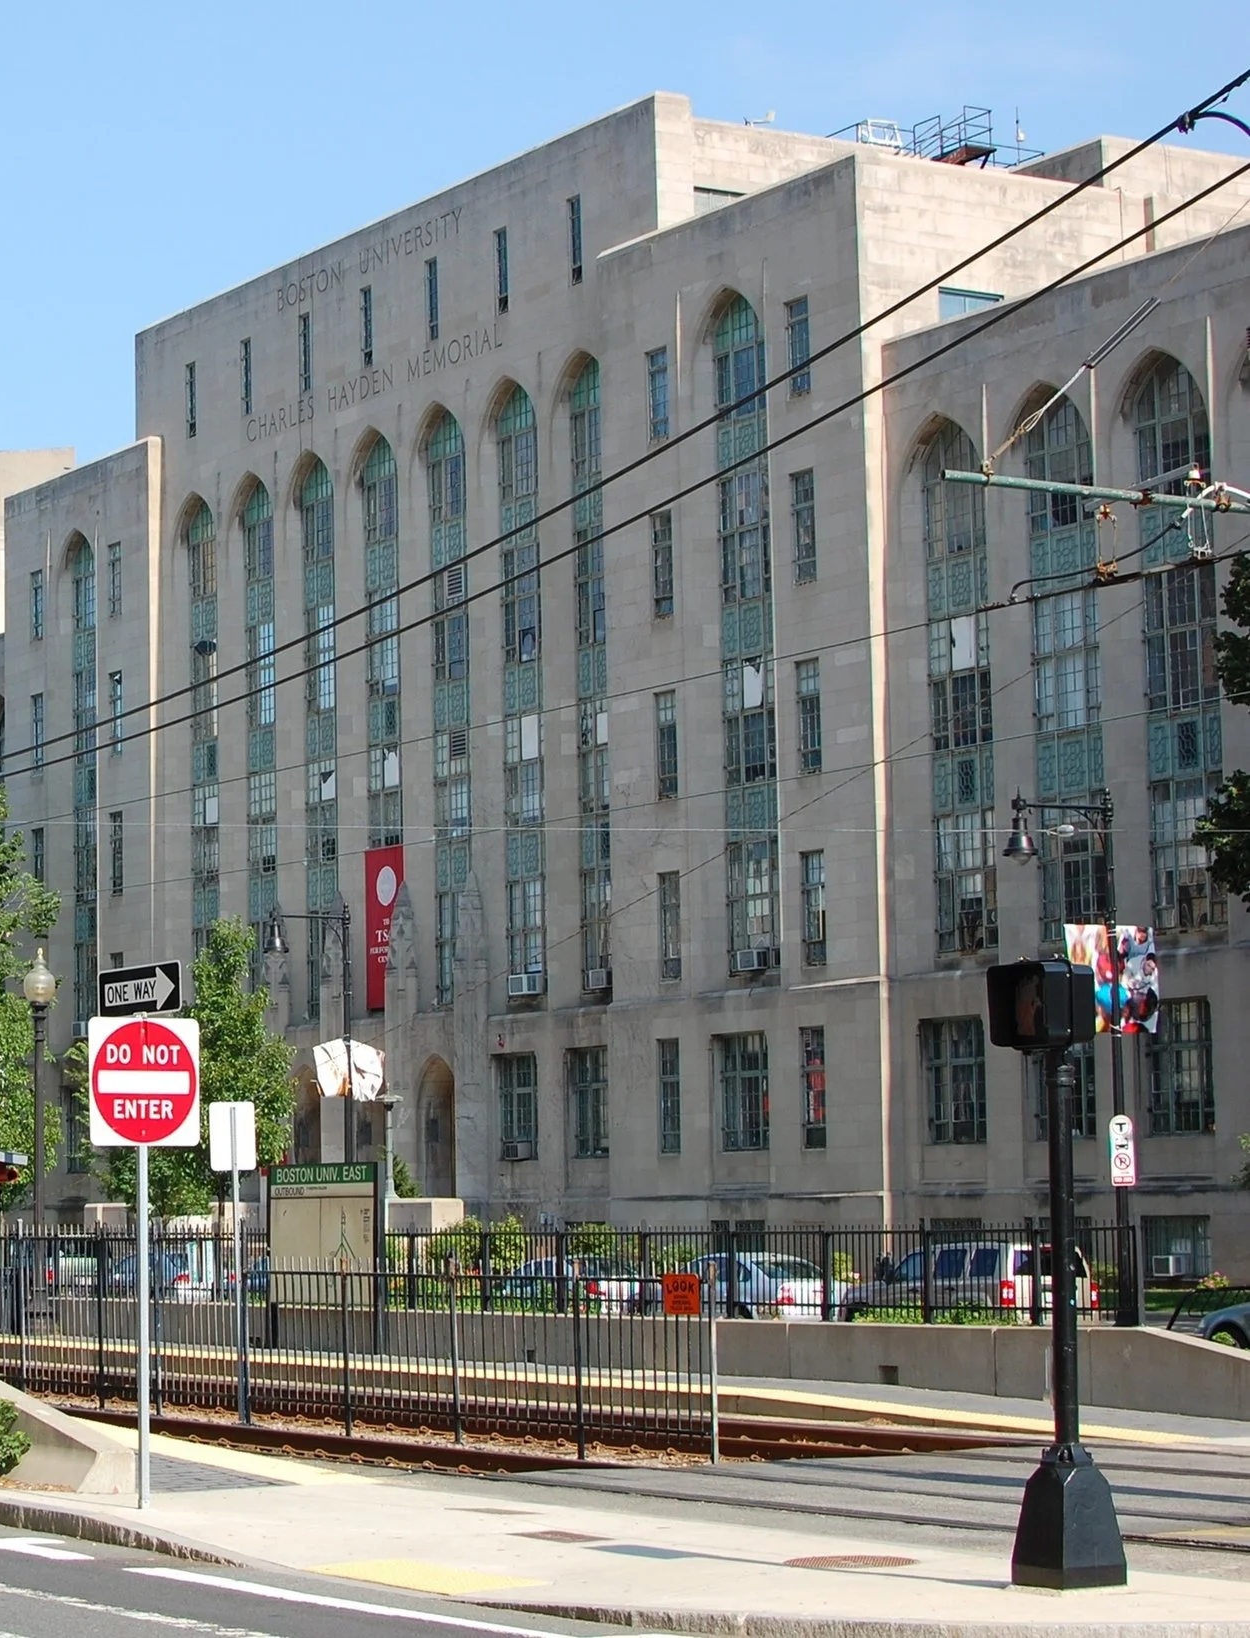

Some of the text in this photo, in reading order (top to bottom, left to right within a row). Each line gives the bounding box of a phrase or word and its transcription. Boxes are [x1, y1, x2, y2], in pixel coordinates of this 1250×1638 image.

[276, 207, 463, 313] BOSTON UNIVERSITY
[246, 324, 503, 442] CHARLES HAYDEN MEMORIAL
[375, 929, 390, 943] TS
[107, 980, 156, 1004] ONE WAY
[105, 1043, 181, 1065] DO NOT
[113, 1099, 174, 1120] ENTER
[276, 1165, 368, 1183] BOSTON UNIV. EAST
[274, 1187, 305, 1196] OUTBOUND
[666, 1280, 695, 1294] LOOK
